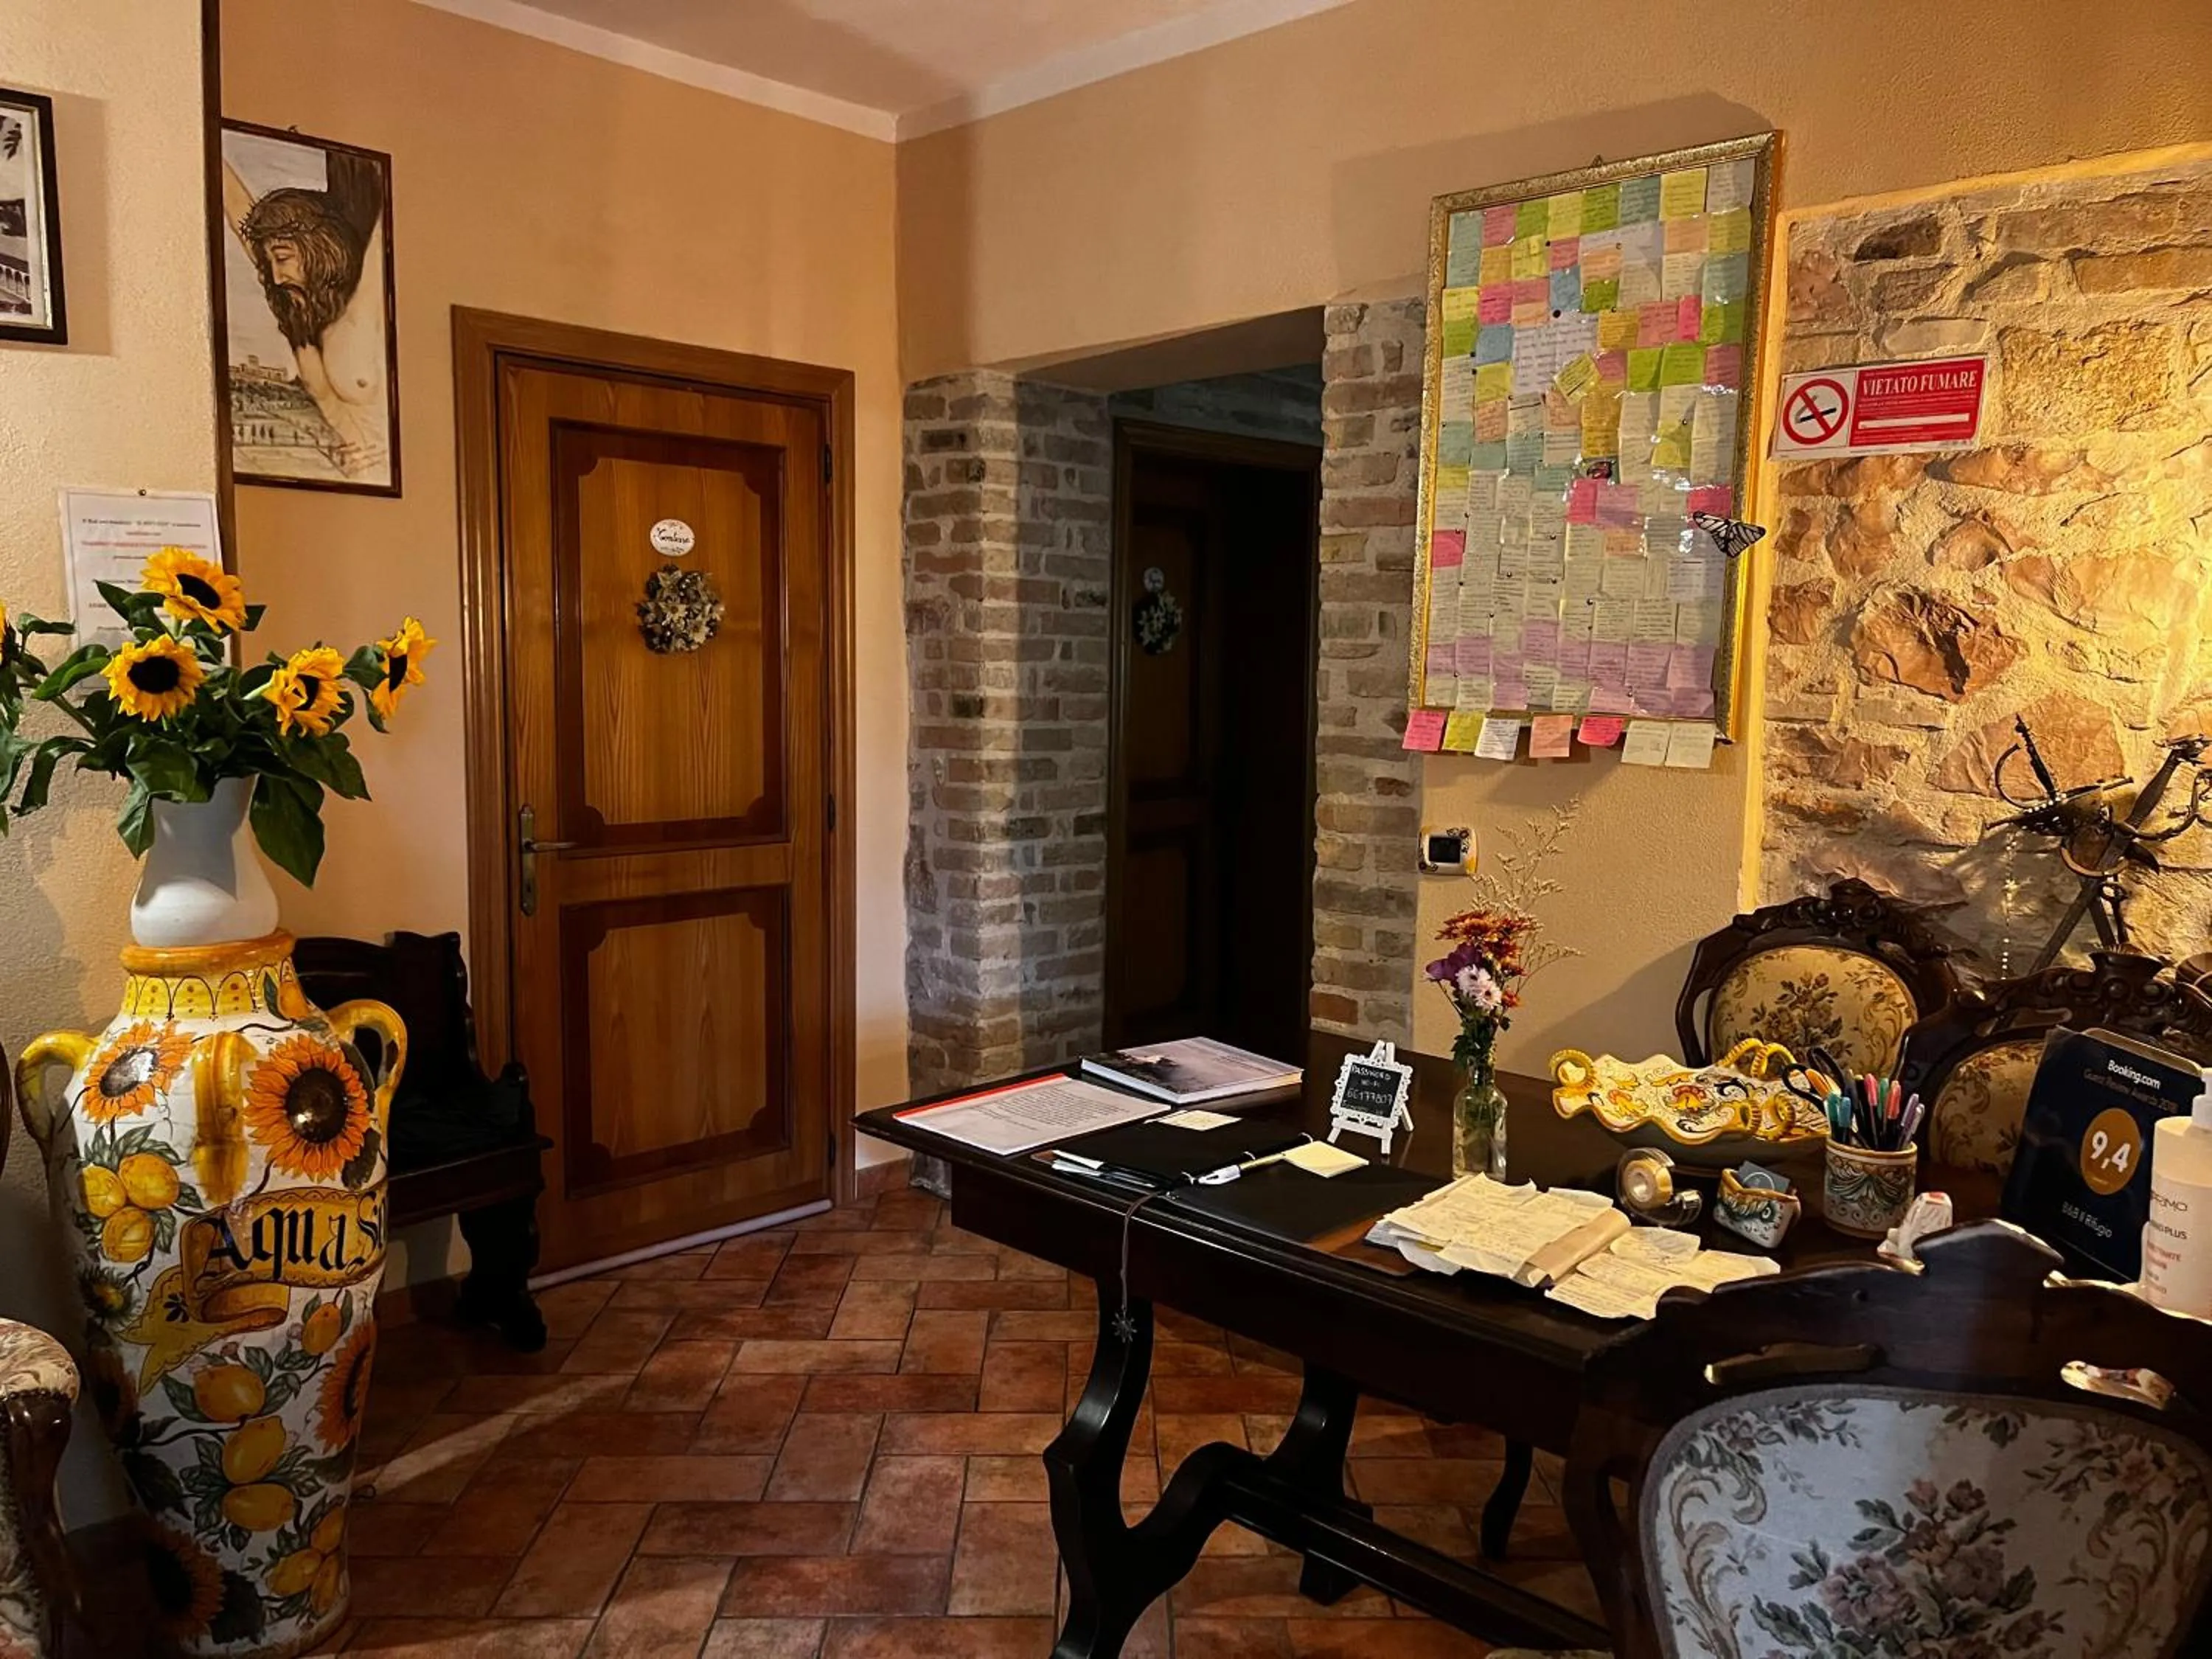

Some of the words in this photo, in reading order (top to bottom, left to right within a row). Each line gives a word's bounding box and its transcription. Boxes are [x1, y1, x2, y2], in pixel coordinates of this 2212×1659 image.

[1863, 376, 1919, 396] VIETATO
[1919, 370, 1978, 392] FUMARE
[2107, 1060, 2162, 1091] Booking.com
[2090, 1130, 2132, 1174] 9,4
